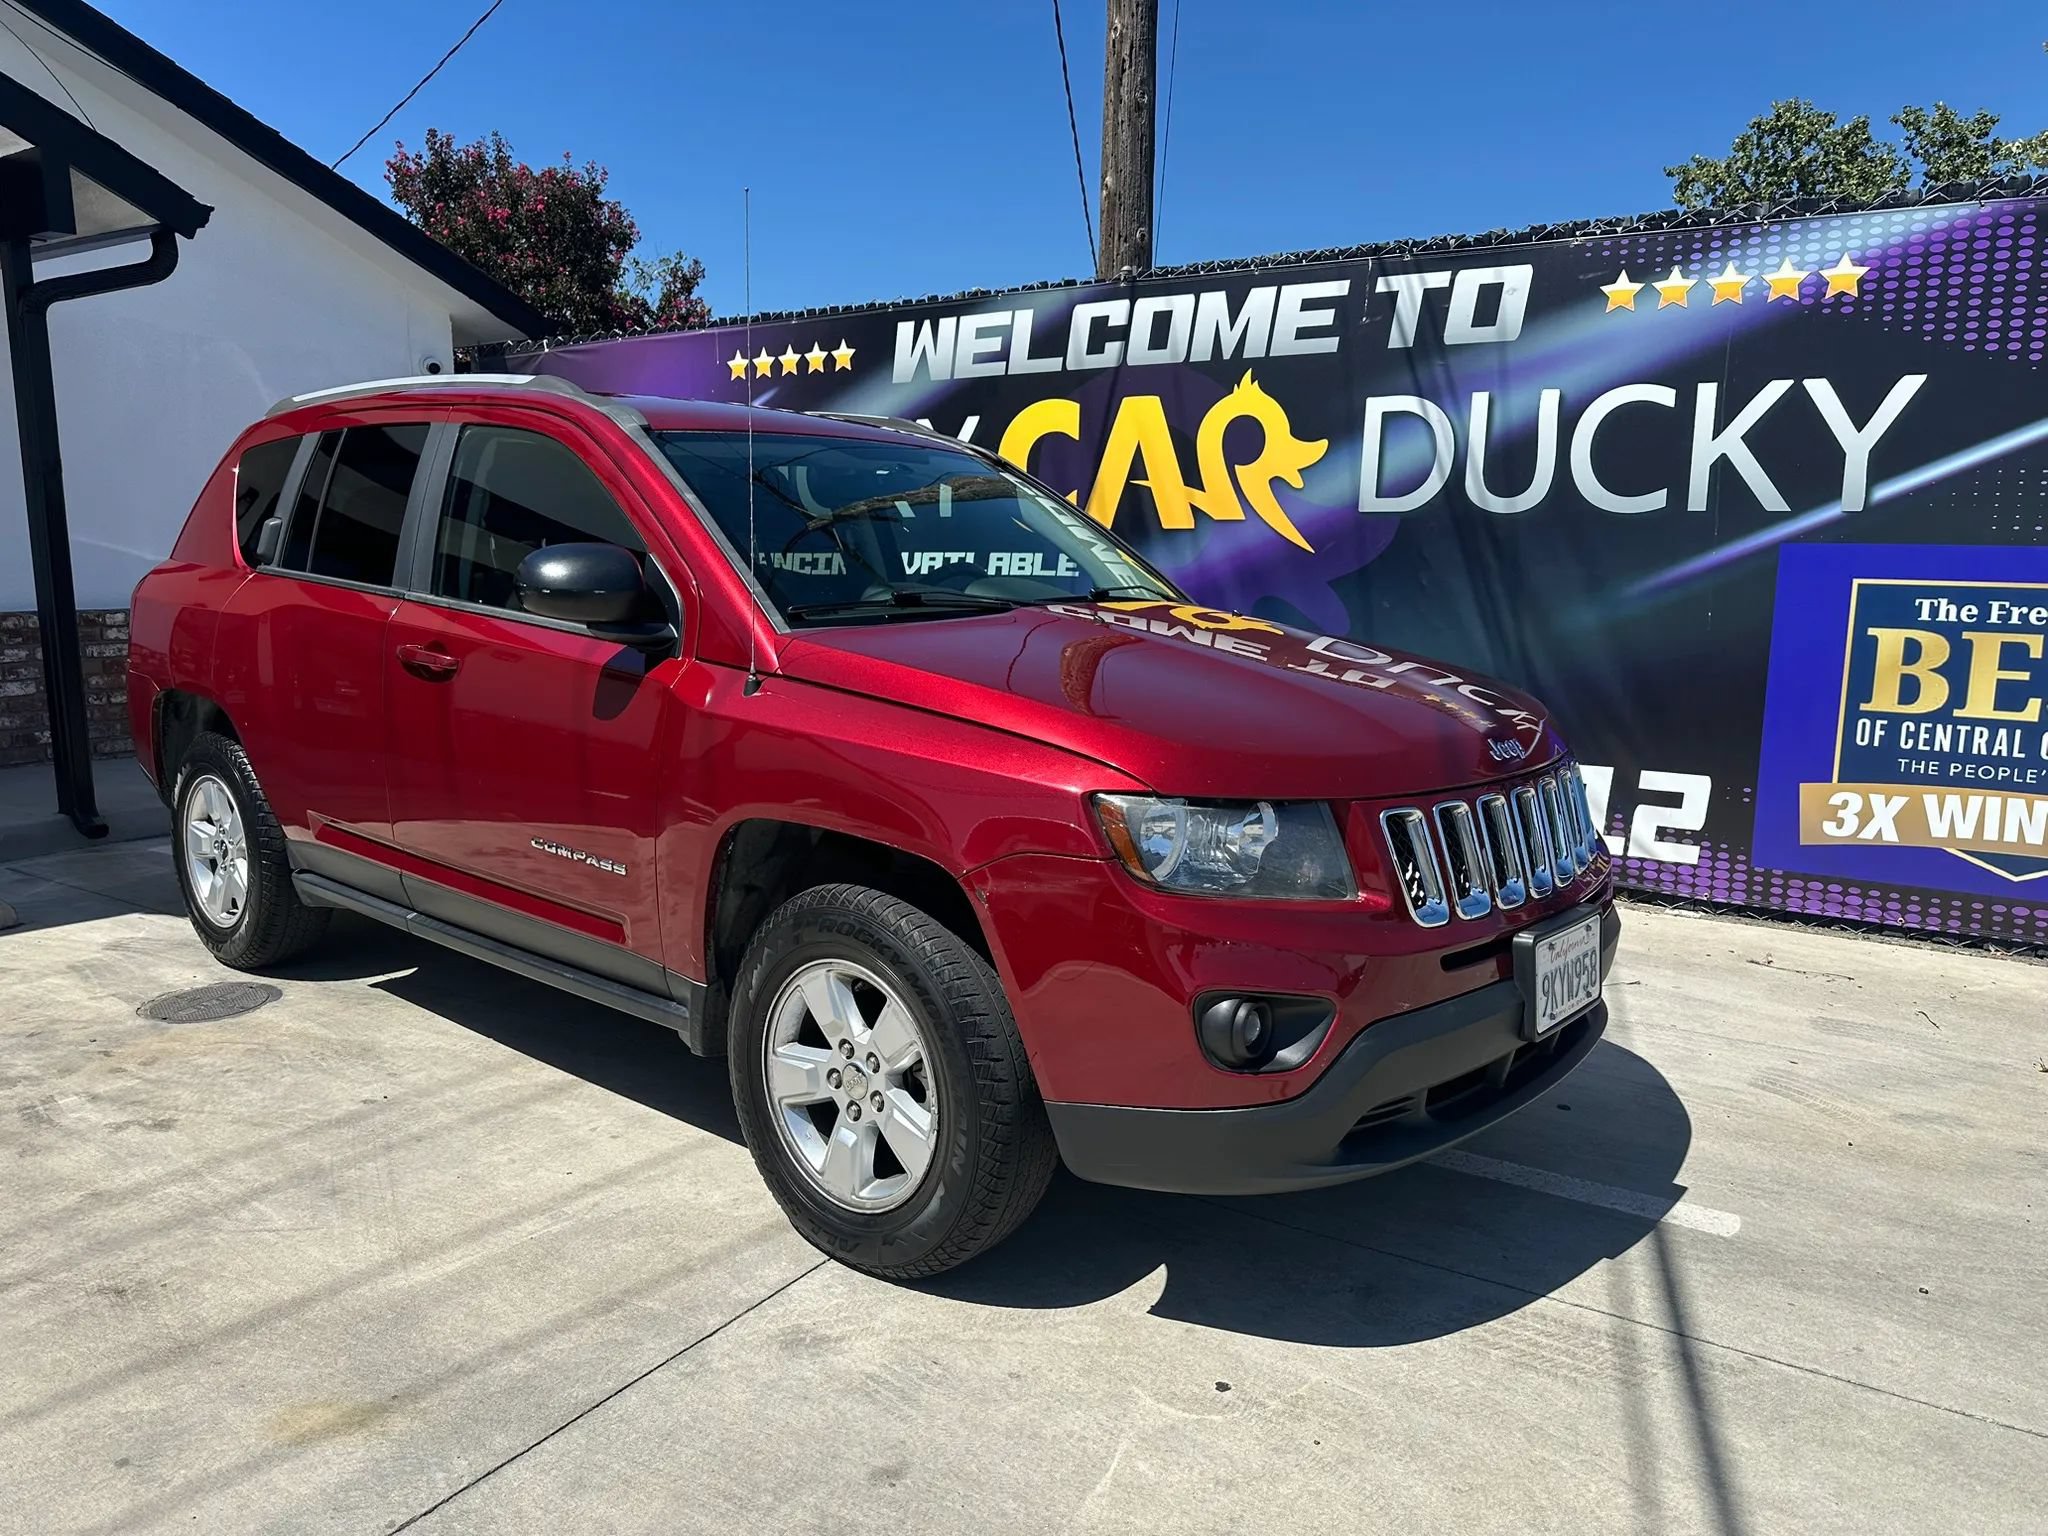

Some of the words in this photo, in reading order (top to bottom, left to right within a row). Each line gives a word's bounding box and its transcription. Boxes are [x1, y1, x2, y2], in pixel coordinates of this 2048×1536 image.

[892, 280, 1350, 383] WELCOME
[1375, 264, 1534, 348] TO
[1358, 374, 1928, 513] DUCKY
[1915, 598, 1979, 622] The
[1859, 627, 2048, 722] BE
[1487, 738, 1526, 760] Jeep
[1856, 718, 1888, 747] OF
[1900, 721, 2026, 758] CENTRAL
[1898, 758, 1940, 776] THE
[1822, 792, 1910, 842] 3X
[1922, 794, 2048, 845] WIN
[531, 836, 627, 876] COMPASS
[1551, 934, 1592, 964] California
